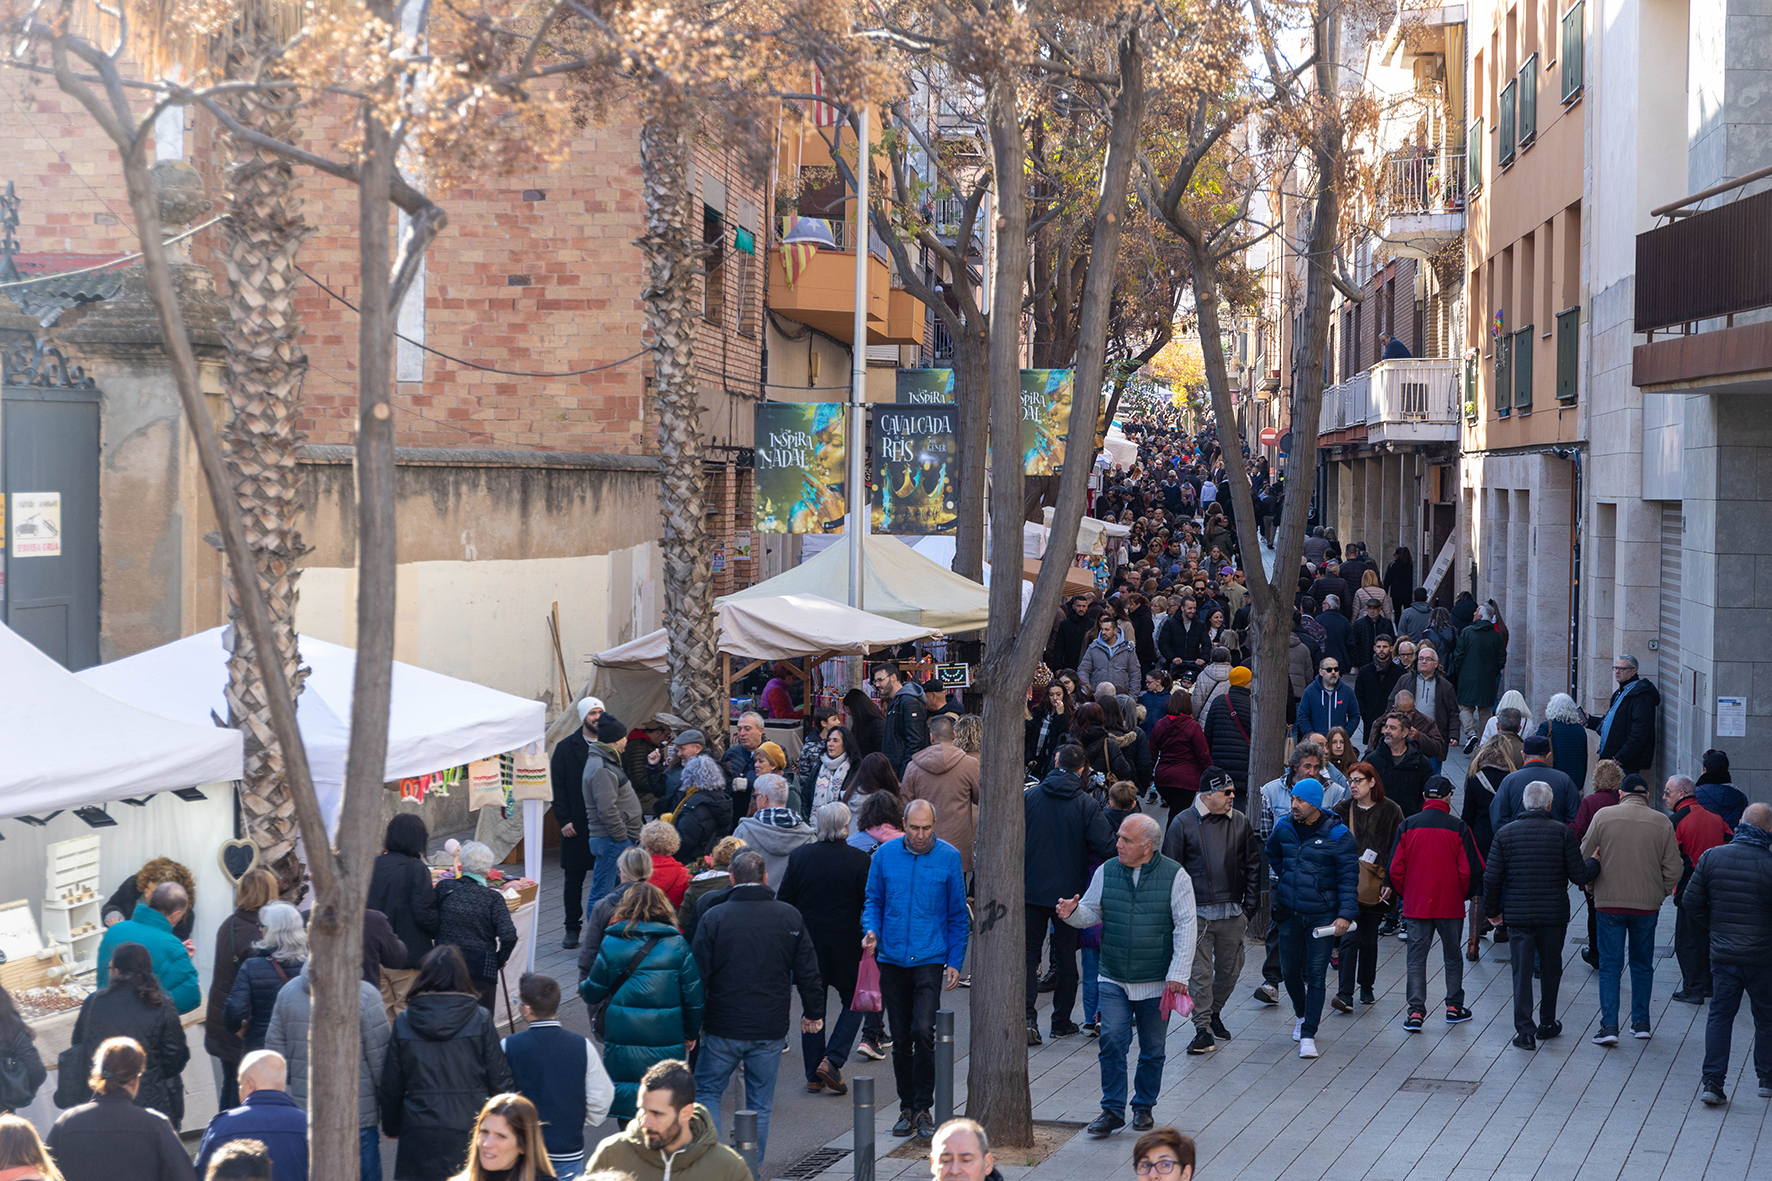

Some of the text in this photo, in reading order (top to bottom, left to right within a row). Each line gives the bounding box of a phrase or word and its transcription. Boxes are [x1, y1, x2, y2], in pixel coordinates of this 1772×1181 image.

[881, 415, 952, 435] CAVALCADA
[927, 444, 947, 452] GENER
[760, 448, 809, 469] NADAL
[42, 542, 59, 551] GRUA
